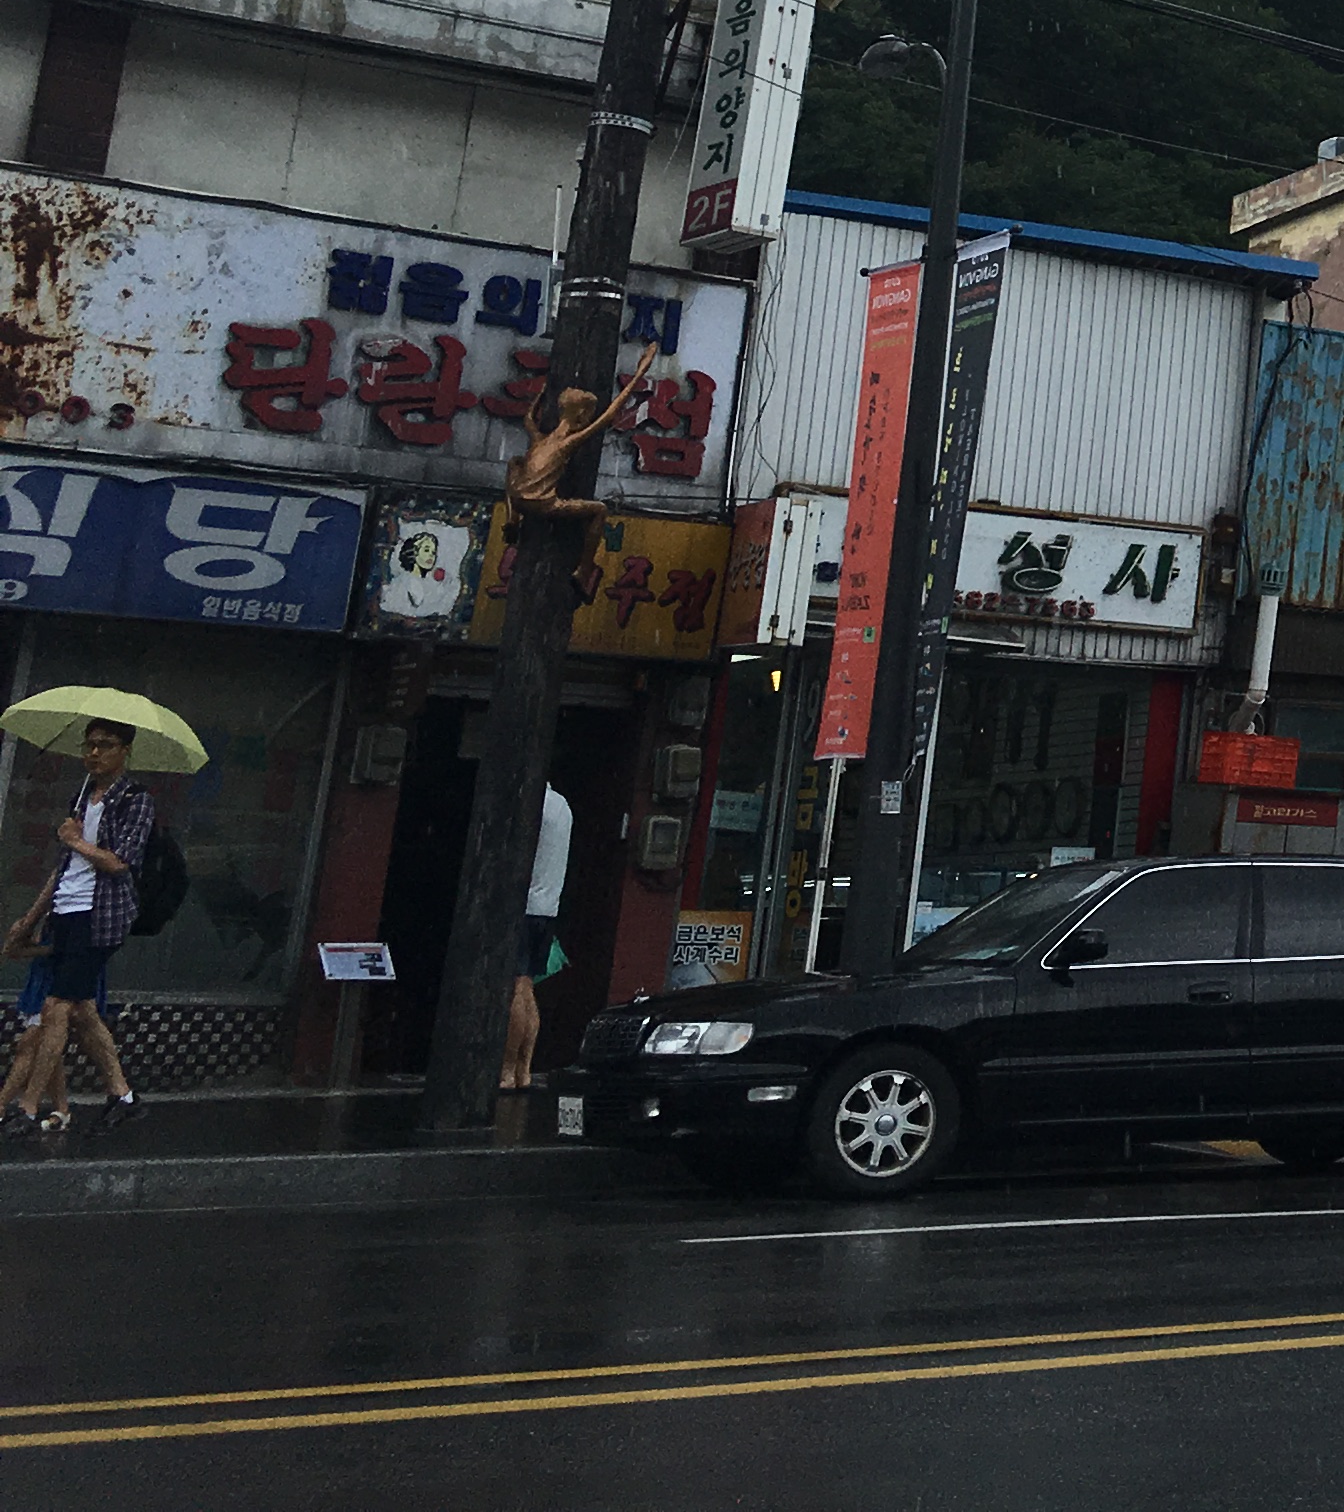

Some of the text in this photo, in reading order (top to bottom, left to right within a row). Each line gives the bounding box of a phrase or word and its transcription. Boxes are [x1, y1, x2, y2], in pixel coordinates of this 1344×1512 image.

[688, 189, 733, 232] 2F
[201, 594, 304, 624] 일반음식점
[676, 923, 743, 944] 금은보석
[672, 944, 741, 967] 시계수리
